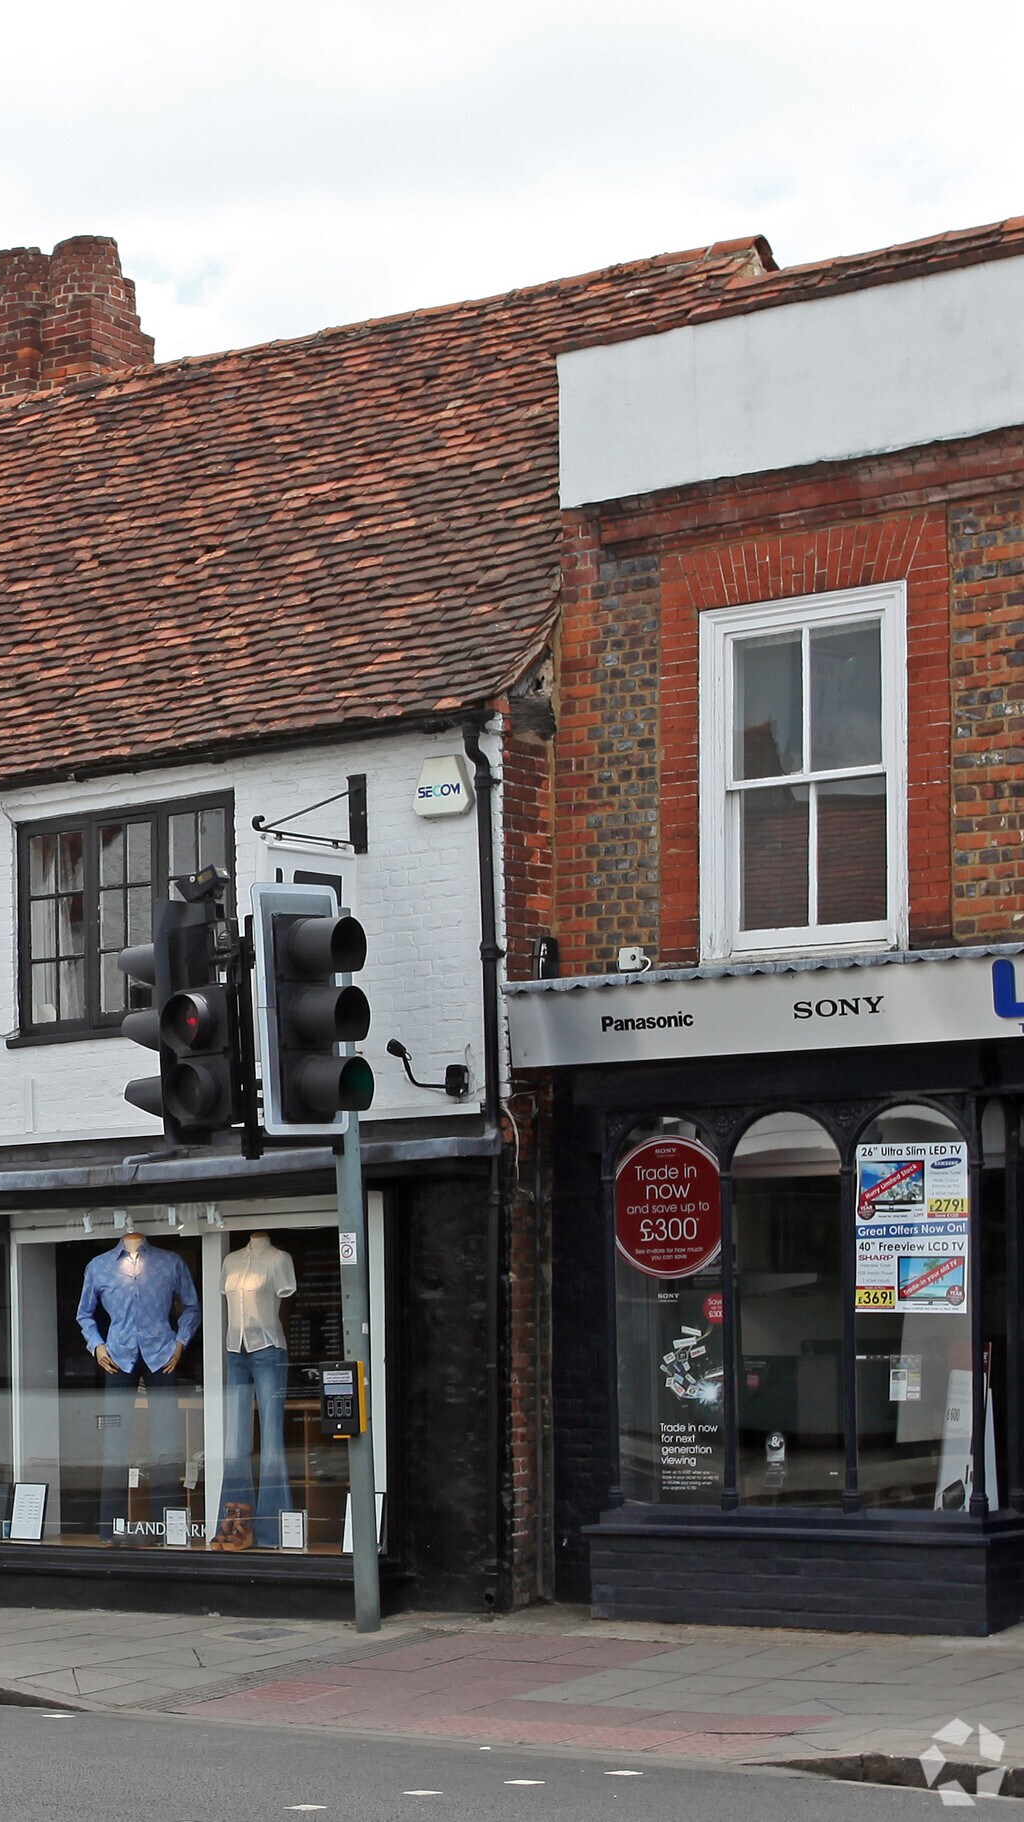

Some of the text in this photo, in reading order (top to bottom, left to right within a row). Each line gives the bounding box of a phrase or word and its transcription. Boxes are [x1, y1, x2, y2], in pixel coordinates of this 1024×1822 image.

[417, 783, 461, 799] SECOM
[793, 995, 884, 1019] SONY
[601, 1010, 694, 1032] Panasonic
[881, 1147, 903, 1156] Ultra
[906, 1146, 926, 1155] Slim
[929, 1146, 947, 1155] LED
[950, 1145, 962, 1154] TV
[635, 1164, 697, 1180] Trade in
[865, 1163, 918, 1199] Hurry Limited Stock
[646, 1183, 690, 1199] now
[627, 1201, 710, 1214] and save up to
[929, 1199, 964, 1212] £279!
[858, 1222, 966, 1236] Great Offers Now On!
[879, 1242, 925, 1251] Freeview
[928, 1242, 949, 1251] LCD
[952, 1242, 964, 1251] TV
[927, 1271, 940, 1283] your
[939, 1264, 950, 1273] old
[949, 1258, 958, 1267] TV
[858, 1291, 893, 1304] £369!
[660, 1423, 685, 1432] Trade
[688, 1423, 696, 1432] in
[661, 1434, 695, 1443] for next
[661, 1445, 712, 1455] generation
[661, 1456, 696, 1467] viewing
